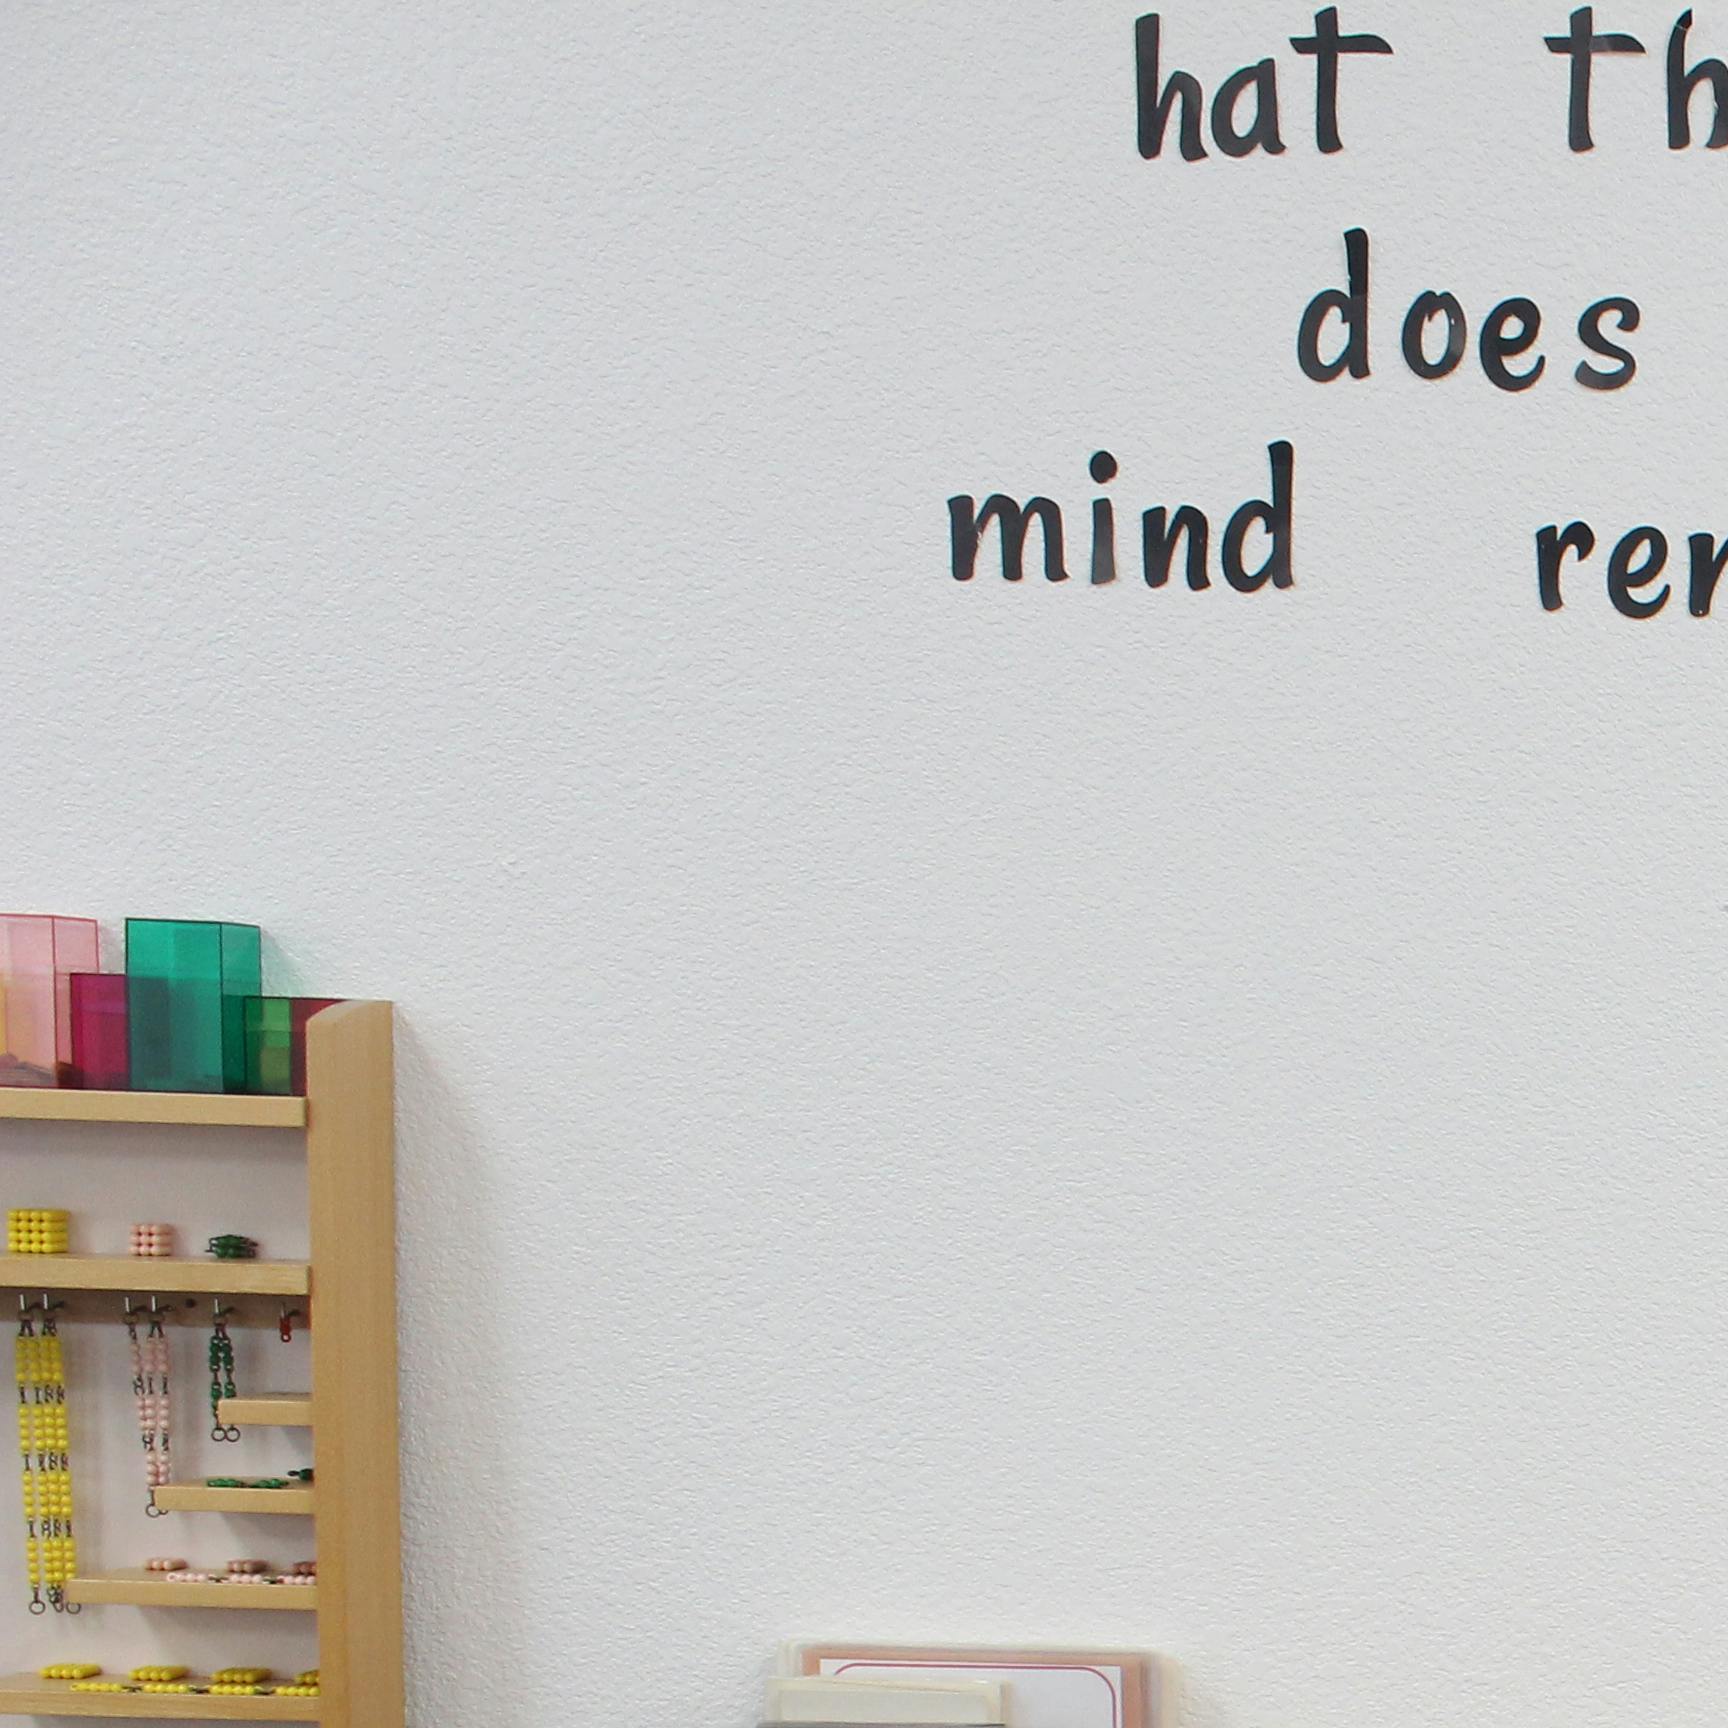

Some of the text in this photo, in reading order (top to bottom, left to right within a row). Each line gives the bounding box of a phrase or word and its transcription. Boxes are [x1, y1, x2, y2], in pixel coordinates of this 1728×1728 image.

[1136, 7, 1393, 161] hat
[1298, 228, 1639, 391] does
[948, 441, 1293, 593] mind
